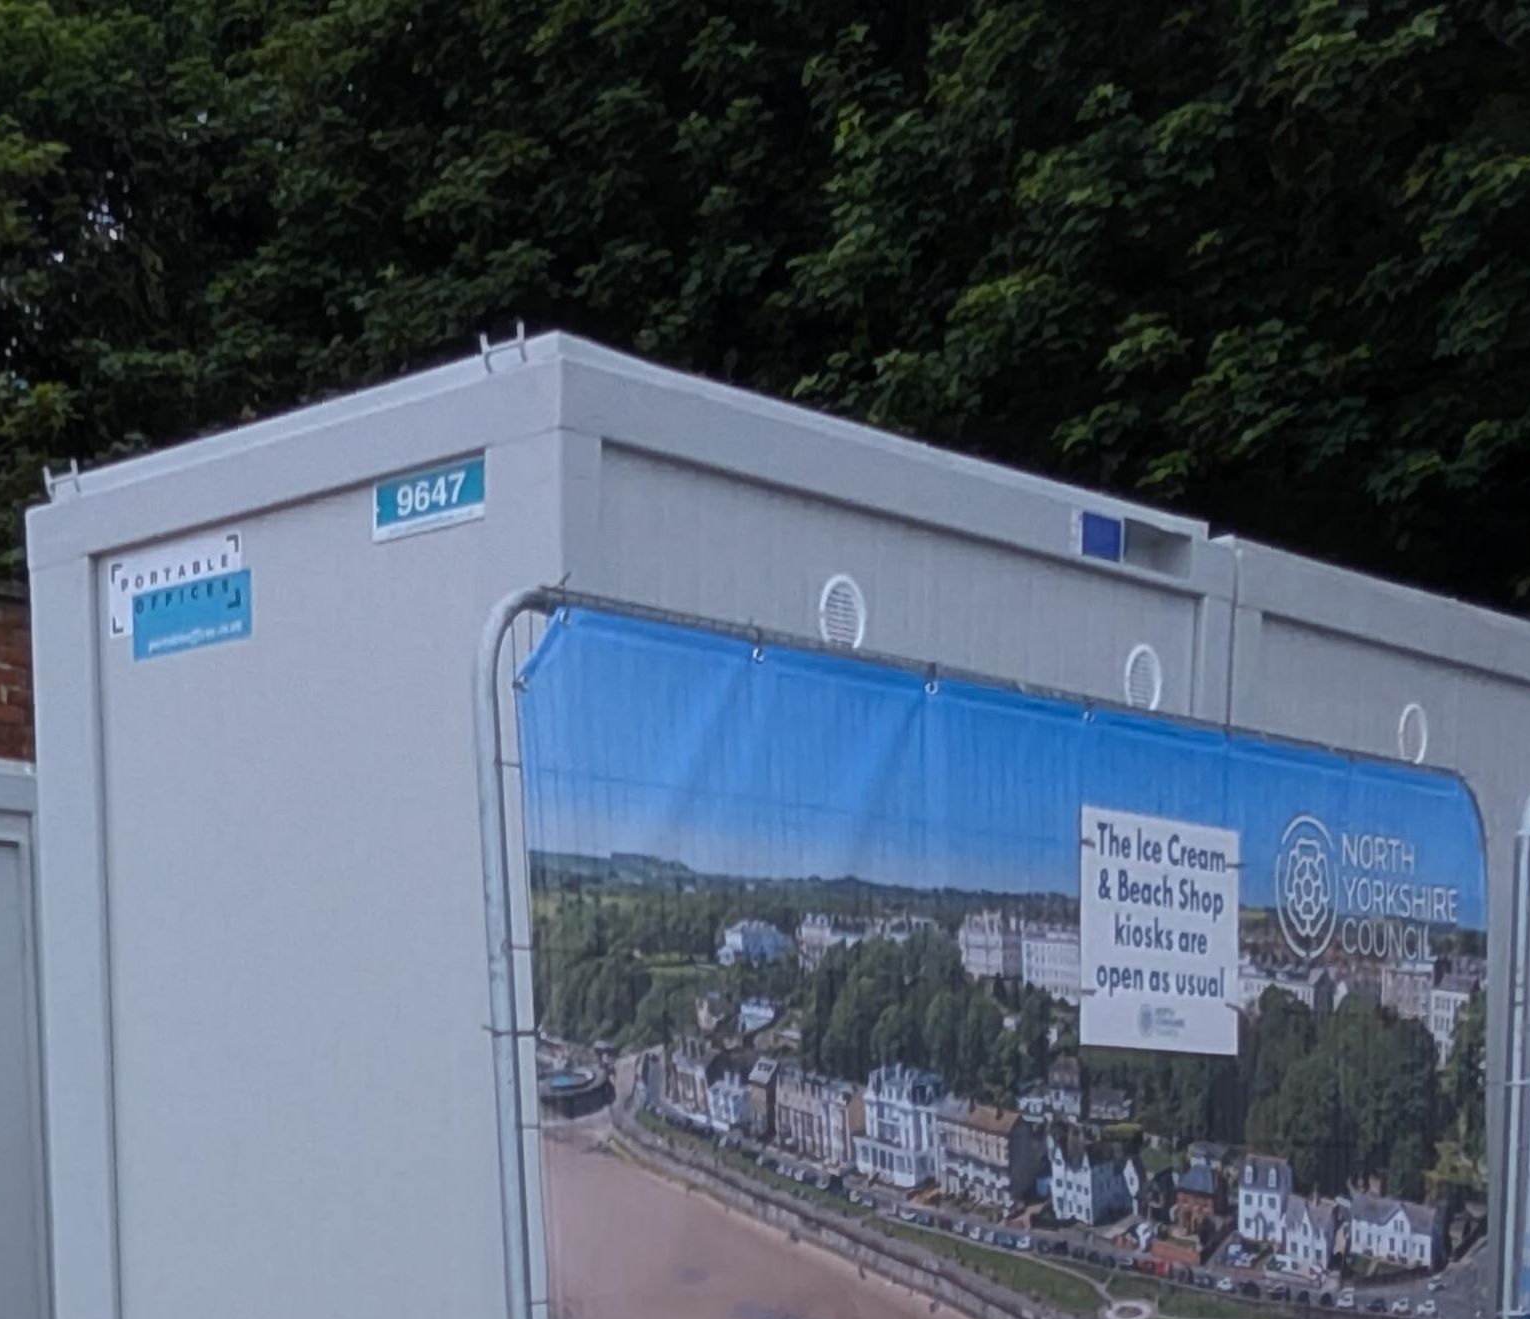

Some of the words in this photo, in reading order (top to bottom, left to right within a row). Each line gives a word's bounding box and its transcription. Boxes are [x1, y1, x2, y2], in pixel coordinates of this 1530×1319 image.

[396, 471, 466, 516] 9647
[120, 554, 228, 592] PORTABLE
[1097, 822, 1131, 859] The
[1136, 828, 1162, 863] Ice
[1168, 834, 1226, 873] Cream
[1342, 833, 1415, 875] NORTH
[1098, 868, 1112, 900] &
[1118, 869, 1173, 907] Beach
[1179, 878, 1224, 923] Shop
[1342, 876, 1457, 922] YORKSHIRE
[1114, 912, 1174, 951] kiosks
[1178, 931, 1208, 955] are
[1342, 918, 1437, 961] COUNCIL
[1096, 965, 1144, 998] open
[1149, 970, 1170, 993] as
[1176, 966, 1225, 998] usual
